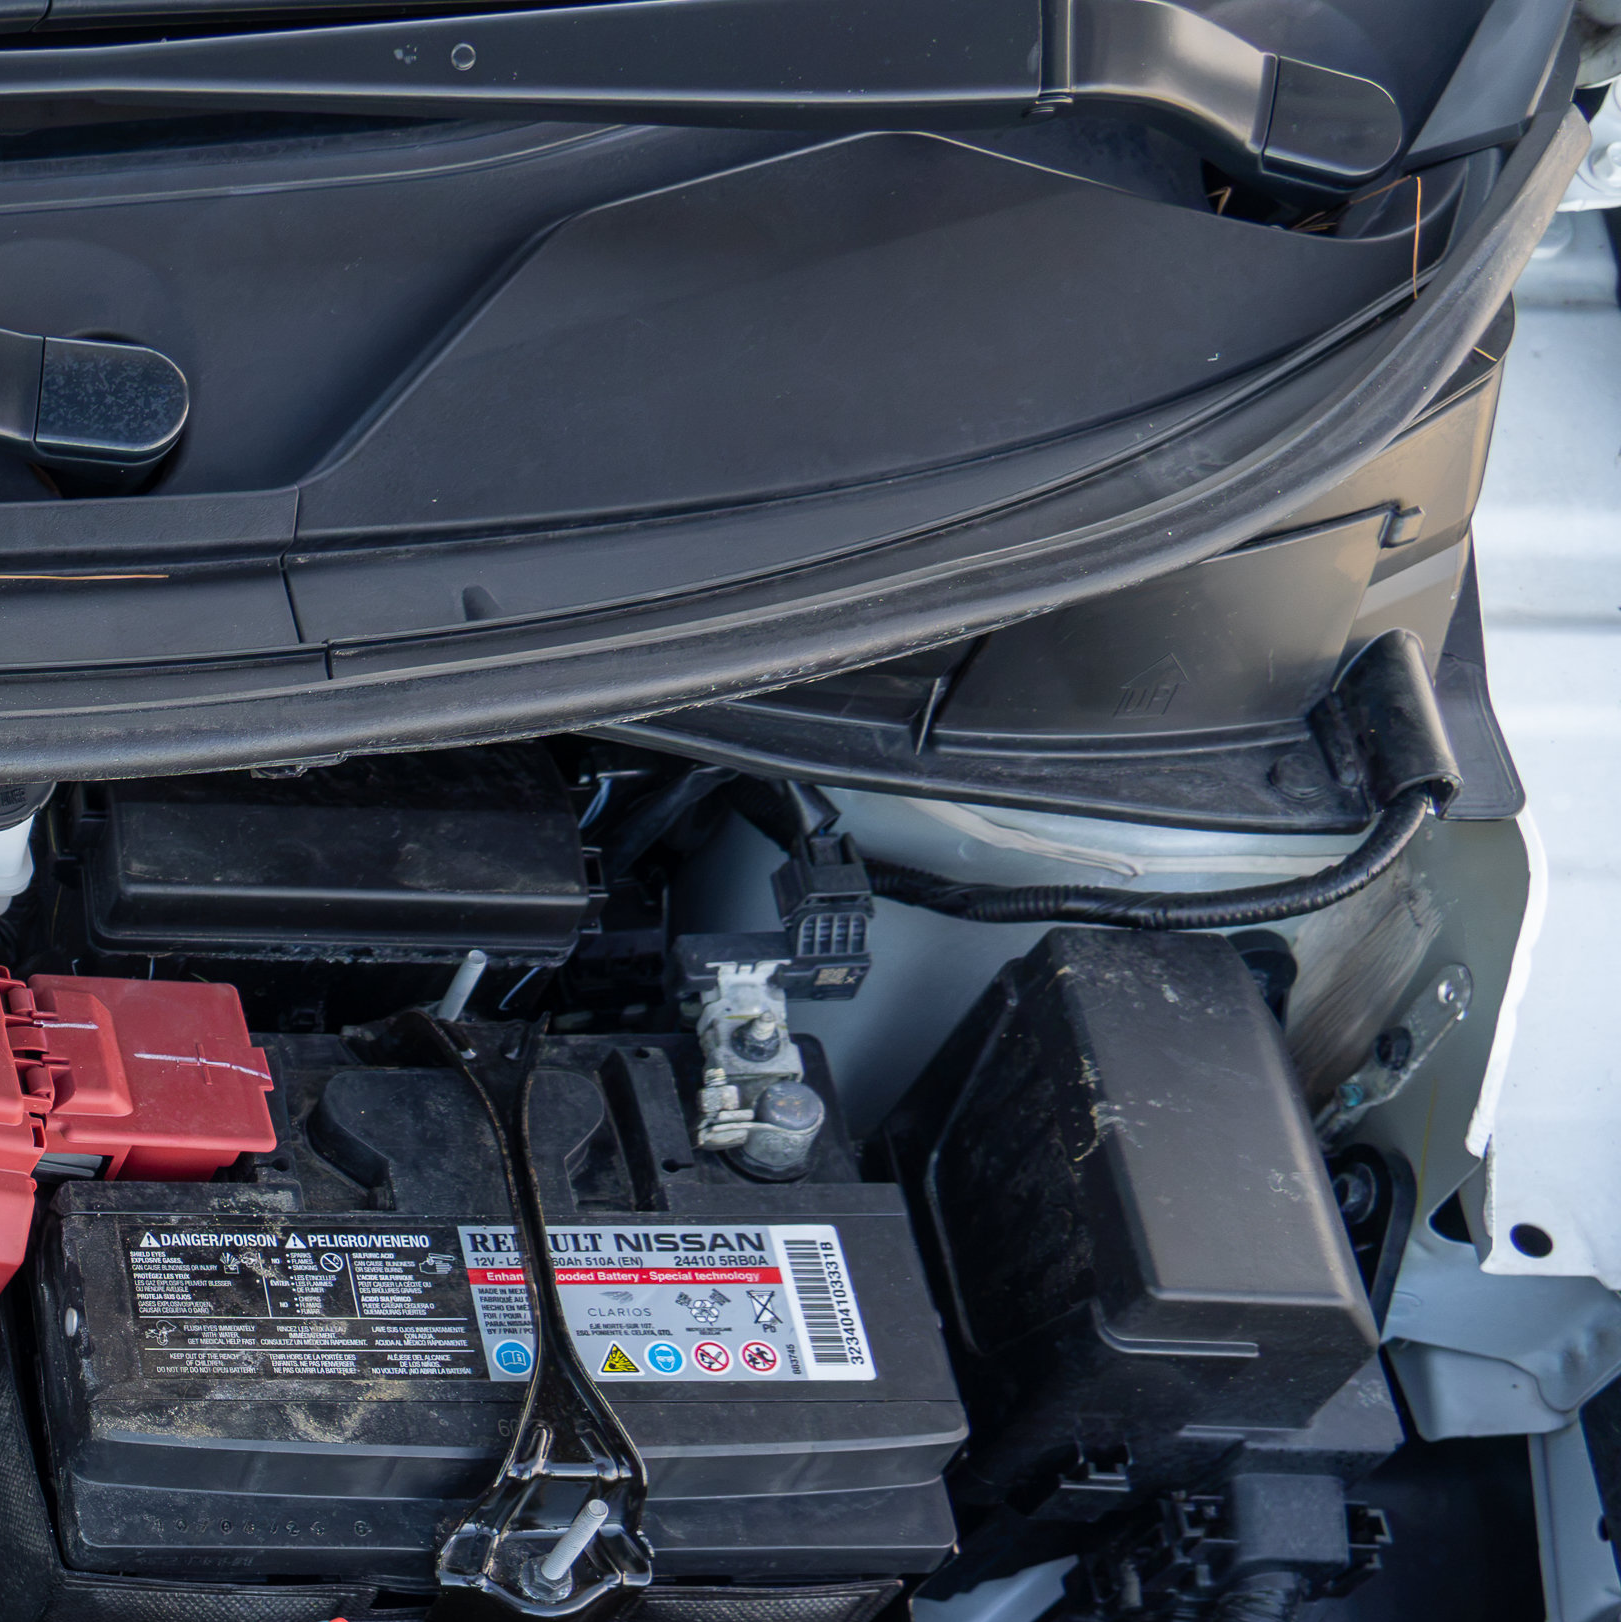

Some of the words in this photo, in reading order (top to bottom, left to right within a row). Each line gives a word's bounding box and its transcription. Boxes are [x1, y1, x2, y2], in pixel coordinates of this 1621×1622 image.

[160, 1233, 278, 1247] DANGER/POISON
[307, 1235, 430, 1248] PELIGRO/VENENO
[467, 1233, 602, 1252] REULT
[613, 1233, 766, 1252] NISSAN
[474, 1257, 495, 1266] 12V
[586, 1257, 615, 1266] 510A
[618, 1257, 643, 1268] (EN)
[674, 1256, 715, 1266] 24410
[487, 1272, 524, 1281] Enhan
[597, 1272, 639, 1283] Battery
[649, 1272, 692, 1282] Special
[695, 1272, 759, 1282] technology
[820, 1241, 865, 1365] 323404103331B
[587, 1308, 652, 1317] CLARIOS
